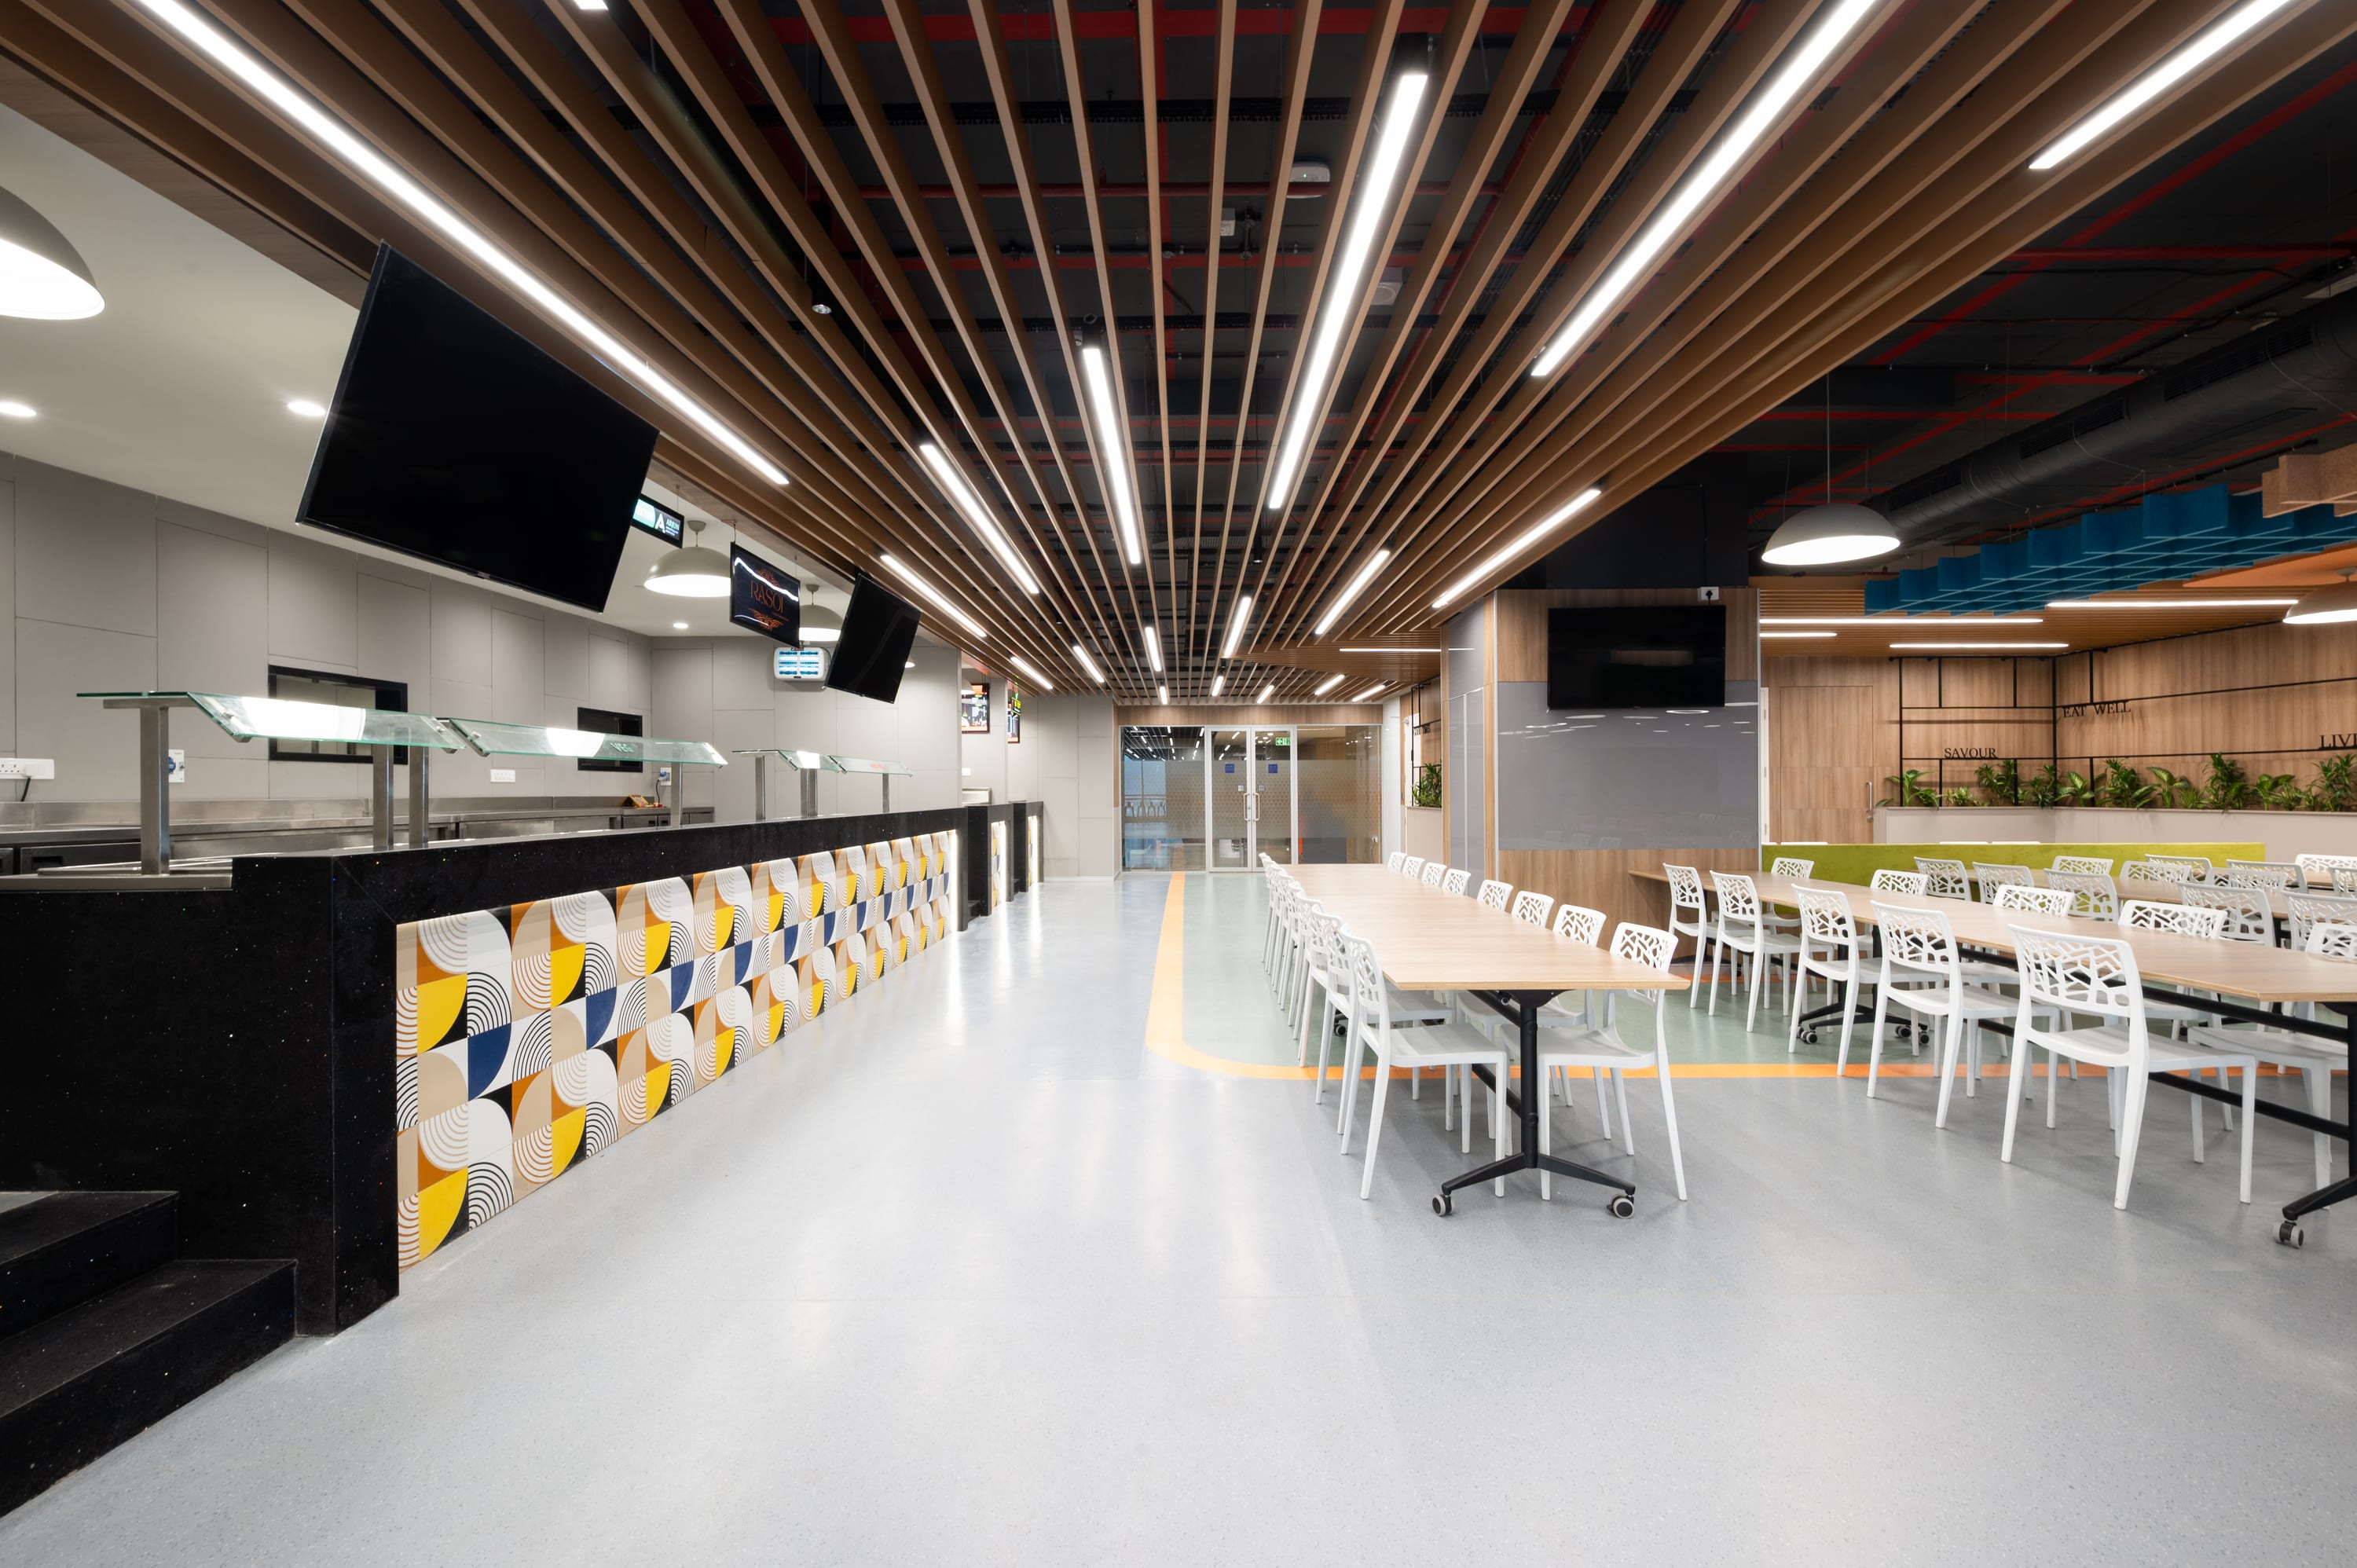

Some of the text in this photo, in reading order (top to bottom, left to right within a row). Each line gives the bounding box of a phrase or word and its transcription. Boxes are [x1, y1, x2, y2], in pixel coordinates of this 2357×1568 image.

[750, 580, 784, 614] RASOI
[2062, 700, 2131, 718] EAT WELL
[1944, 747, 1999, 760] SAVOUR
